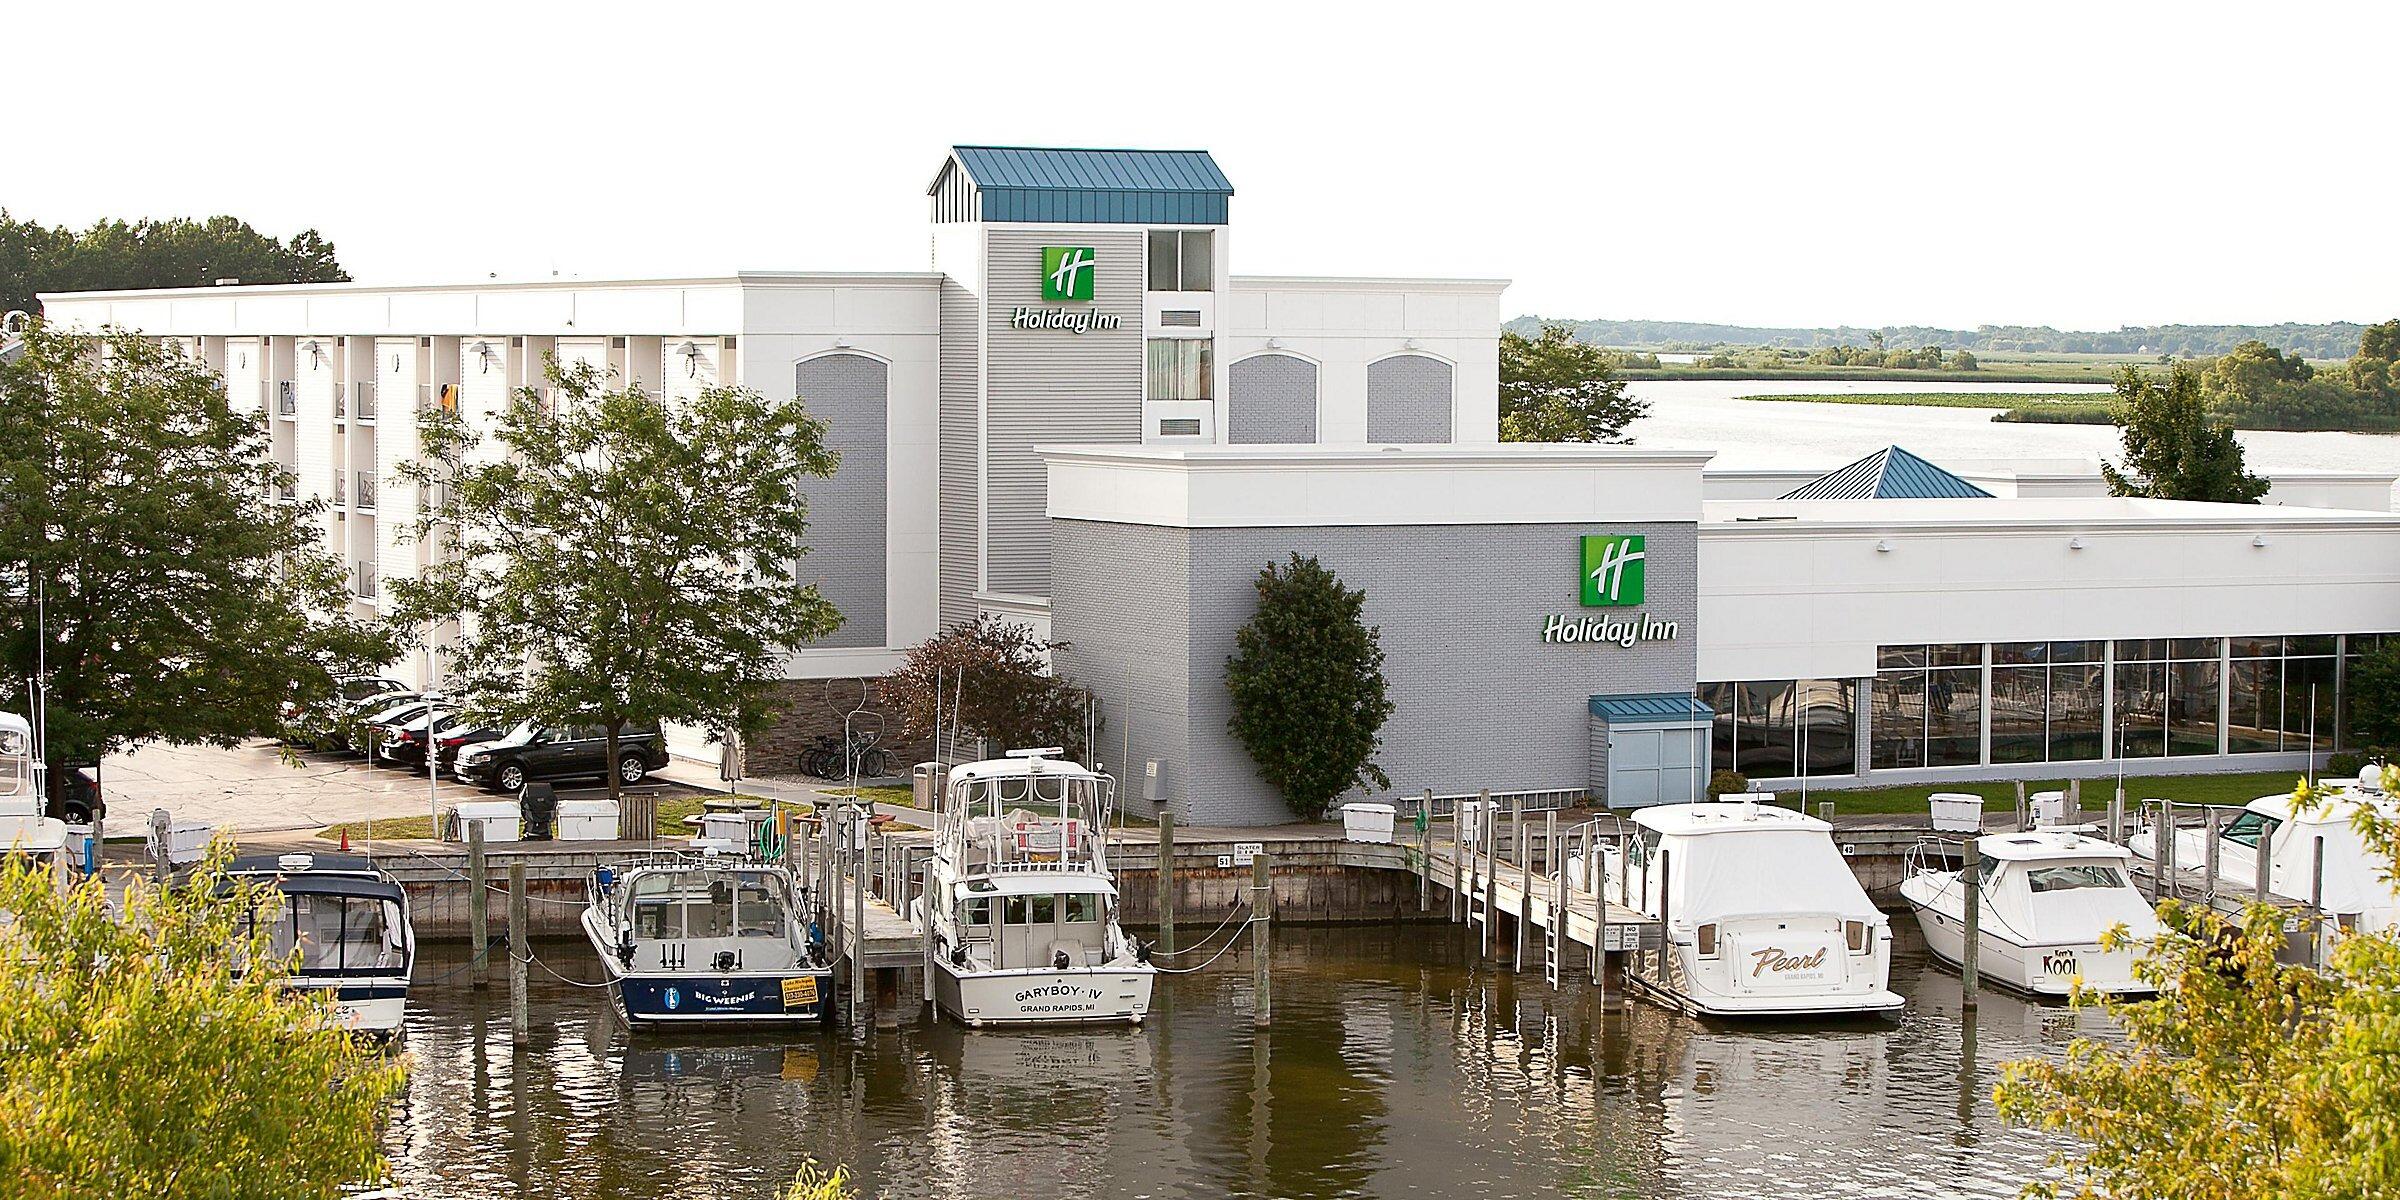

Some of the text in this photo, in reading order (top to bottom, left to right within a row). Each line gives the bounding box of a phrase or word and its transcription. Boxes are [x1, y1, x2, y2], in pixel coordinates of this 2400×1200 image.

[1012, 306, 1122, 334] Holiday Inn
[1543, 612, 1678, 648] Holiday Inn
[1219, 857, 1228, 866] 51
[1751, 946, 1827, 977] Pearl
[695, 991, 755, 1005] BIG WEENIE
[1015, 985, 1103, 1002] GARYBOY IV
